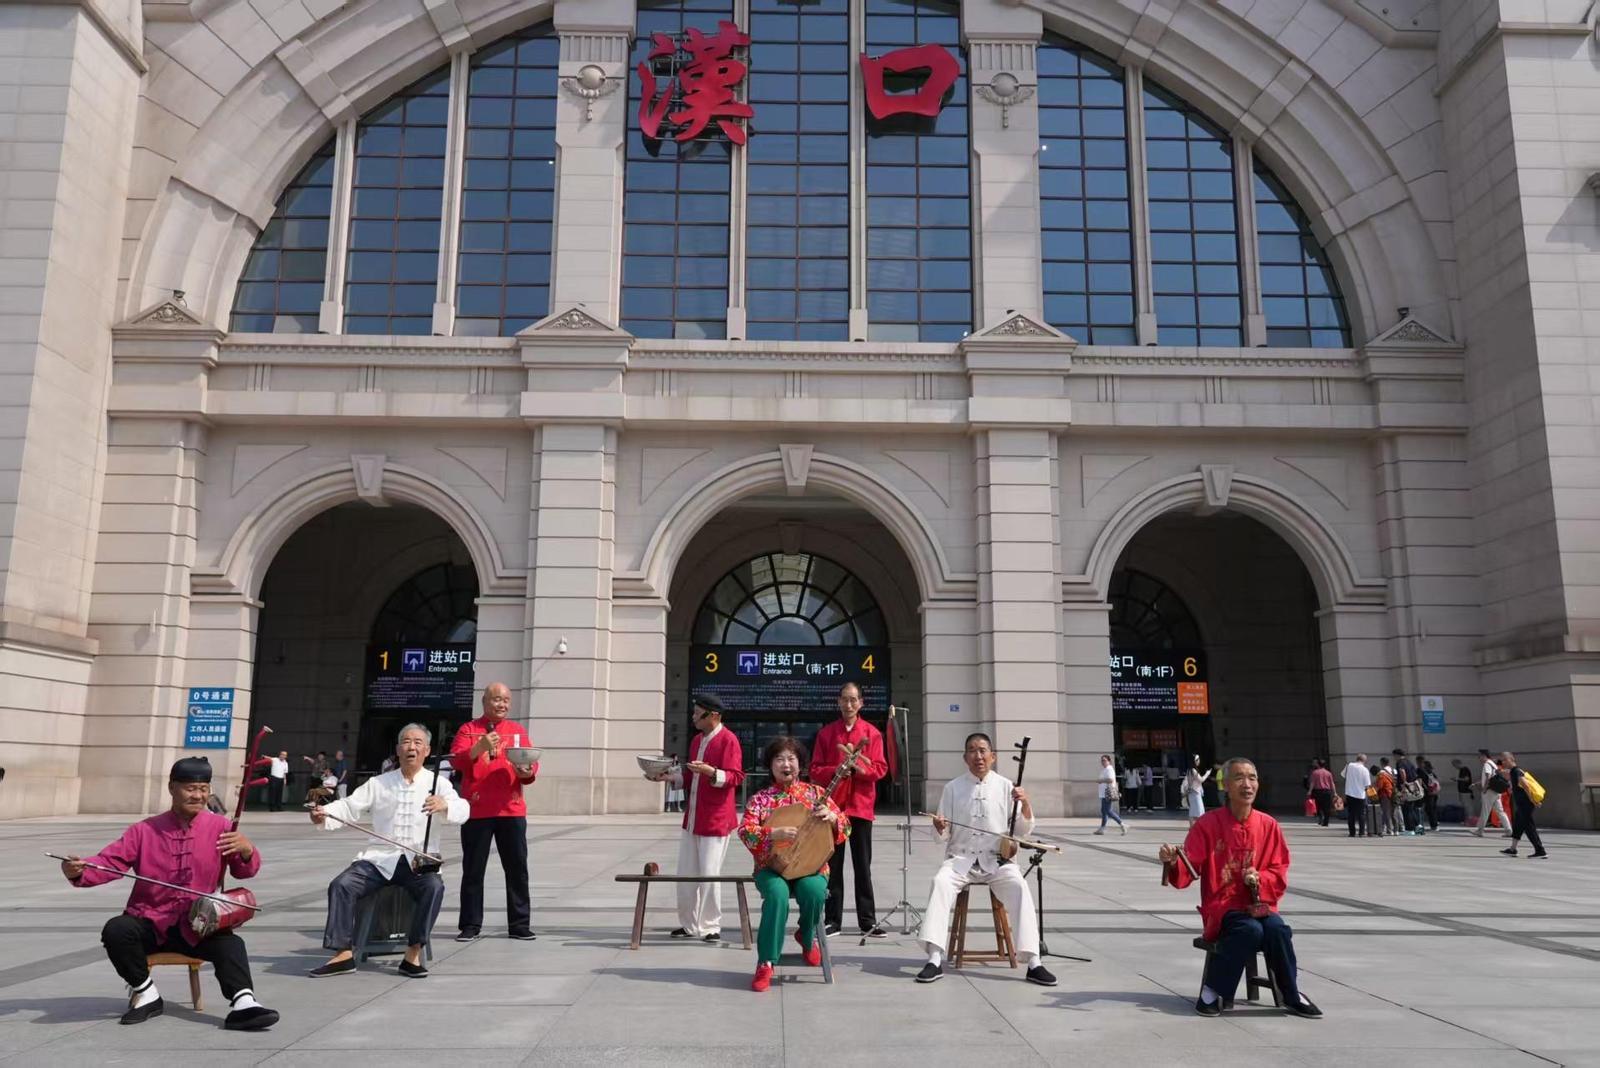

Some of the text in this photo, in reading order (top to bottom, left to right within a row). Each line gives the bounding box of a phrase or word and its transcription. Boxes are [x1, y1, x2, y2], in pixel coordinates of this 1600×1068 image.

[637, 20, 960, 146] 漢口
[379, 651, 388, 670] 1
[429, 650, 472, 664] 进站口
[705, 653, 718, 672] 3
[763, 653, 804, 666] 进站口
[861, 654, 875, 673] 4
[428, 665, 458, 673] Entrance
[763, 667, 792, 675] Entrance
[1184, 657, 1197, 677] 6
